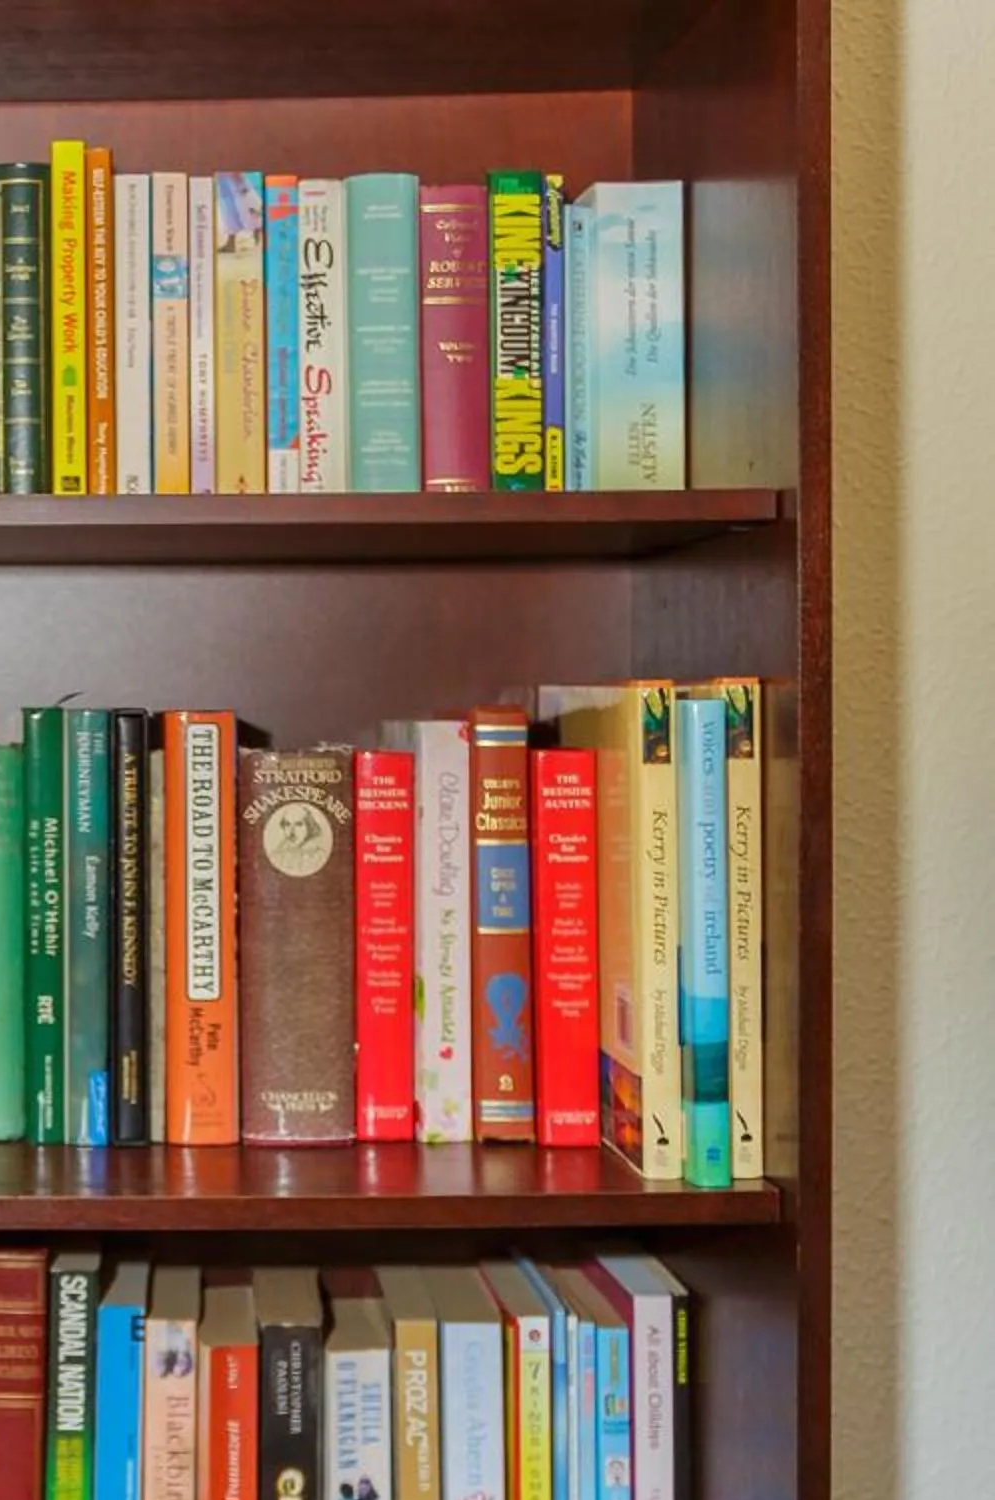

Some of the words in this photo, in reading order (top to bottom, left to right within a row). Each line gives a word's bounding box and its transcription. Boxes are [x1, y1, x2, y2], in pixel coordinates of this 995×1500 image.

[57, 170, 77, 230] Making
[92, 229, 106, 245] THE
[92, 247, 106, 266] KEY
[494, 193, 542, 269] KING
[57, 238, 77, 306] Property
[92, 269, 106, 281] TO
[92, 282, 106, 308] YOUR
[300, 238, 333, 353] Effective
[63, 313, 77, 353] Work
[92, 310, 106, 345] CHILD'S
[497, 270, 532, 374] KINGDOM
[92, 348, 106, 398] EDUCATION
[300, 365, 333, 485] Speaking
[494, 377, 542, 474] KINGS
[640, 402, 657, 484] ALPSTEN
[123, 753, 137, 763] A
[193, 730, 213, 772] THE
[252, 770, 343, 785] STRATFORD
[702, 721, 720, 776] voices
[76, 730, 92, 833] JOURNEYMAN
[123, 767, 137, 828] TRIBUTE
[193, 780, 213, 838] ROAD
[243, 786, 353, 826] SHAKESPEARE
[371, 776, 396, 787] THE
[555, 774, 579, 785] THE
[43, 817, 59, 884] Michael
[123, 833, 137, 855] TO
[193, 844, 213, 871] TO
[433, 825, 461, 897] Dowling
[647, 809, 669, 868] Kerry
[697, 821, 721, 880] poetry
[730, 806, 753, 862] Kerry
[84, 855, 100, 901] Éamon
[120, 858, 137, 899] JOHN
[653, 873, 668, 890] in
[737, 867, 752, 884] in
[43, 891, 59, 957] O'Hehir
[84, 905, 100, 939] Kelly
[123, 914, 137, 986] KENNEDY
[193, 879, 213, 994] McCARTHY
[652, 896, 669, 966] Pictures
[703, 909, 722, 976] ireland
[737, 890, 753, 962] Pictures
[186, 1006, 204, 1067] McCarthy
[206, 1023, 221, 1051] Pete
[56, 1275, 87, 1363] SCANDAL
[647, 1326, 662, 1347] All
[56, 1364, 84, 1430] NATION
[289, 1340, 302, 1435] CHRISTOPHER
[336, 1361, 357, 1470] O'FLANAGAN
[361, 1382, 381, 1446] SHEILA
[404, 1350, 428, 1447] PROZAC
